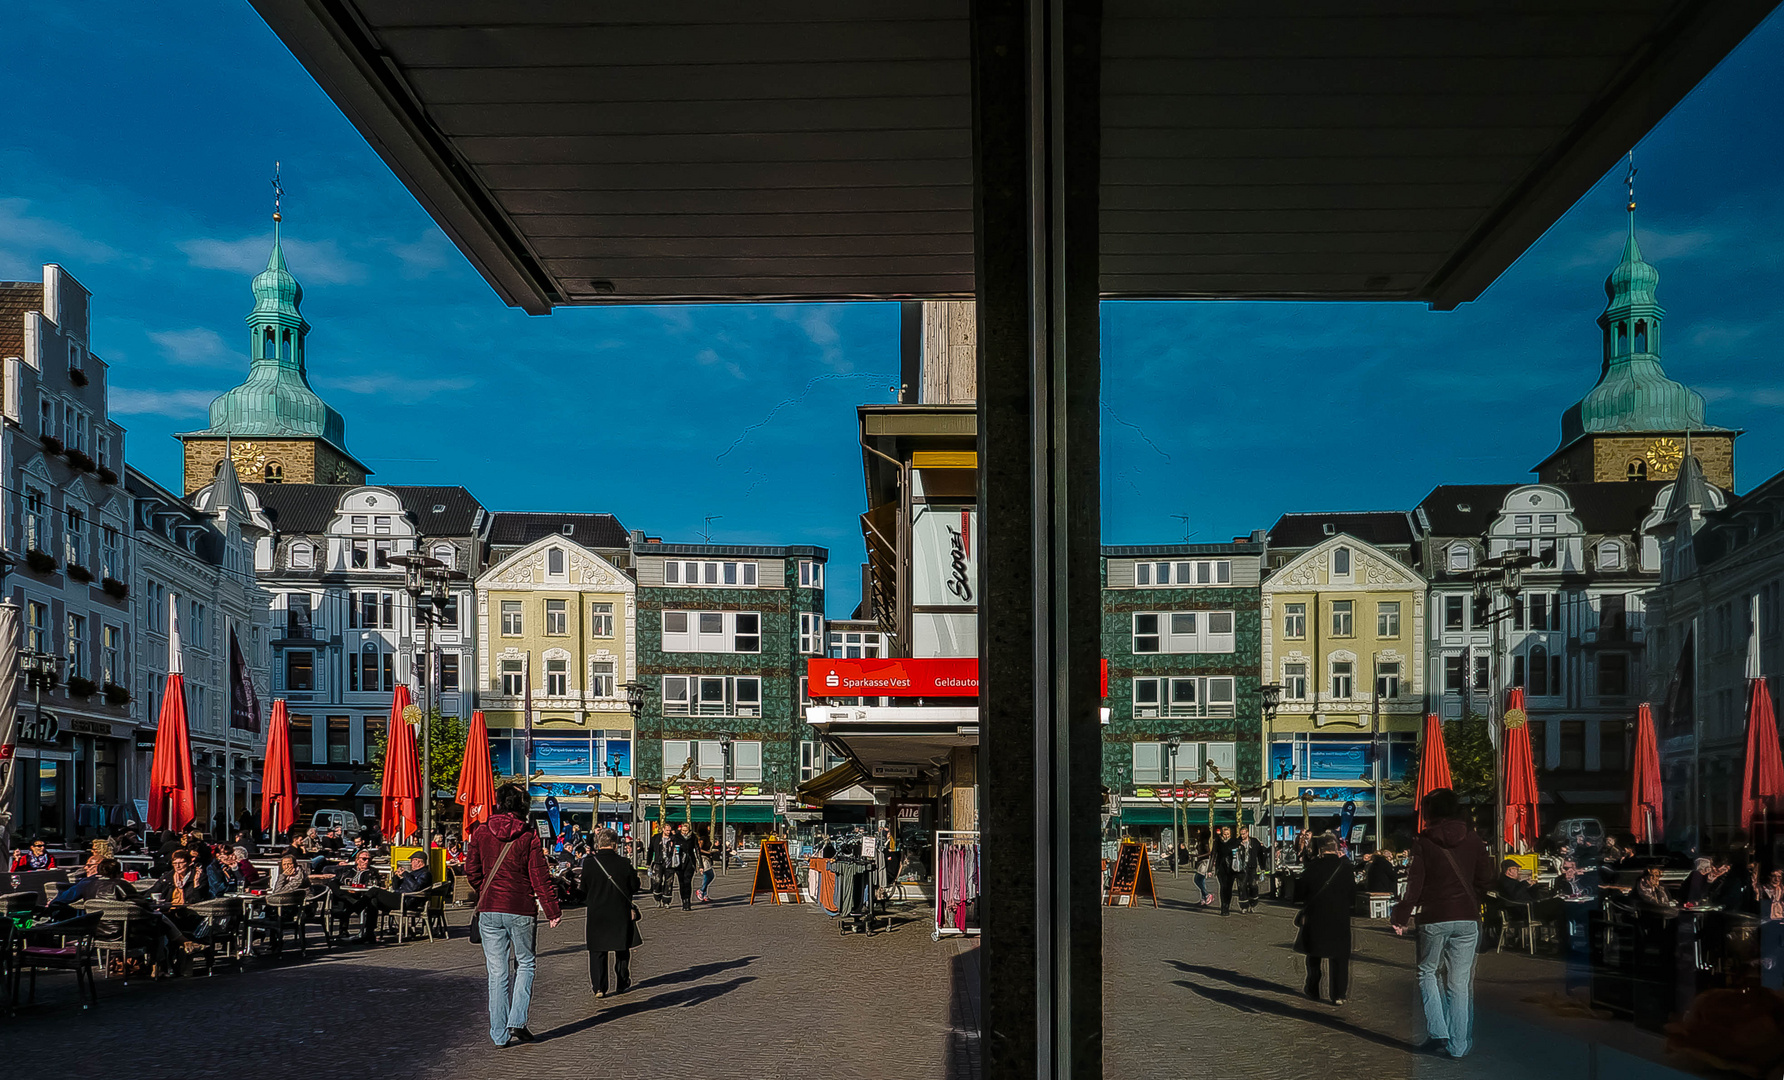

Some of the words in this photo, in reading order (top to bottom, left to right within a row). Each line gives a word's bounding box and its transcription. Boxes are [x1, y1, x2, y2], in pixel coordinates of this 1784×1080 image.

[843, 677, 889, 689] Sparkasse
[890, 677, 911, 687] Vest
[897, 808, 919, 818] Alle
